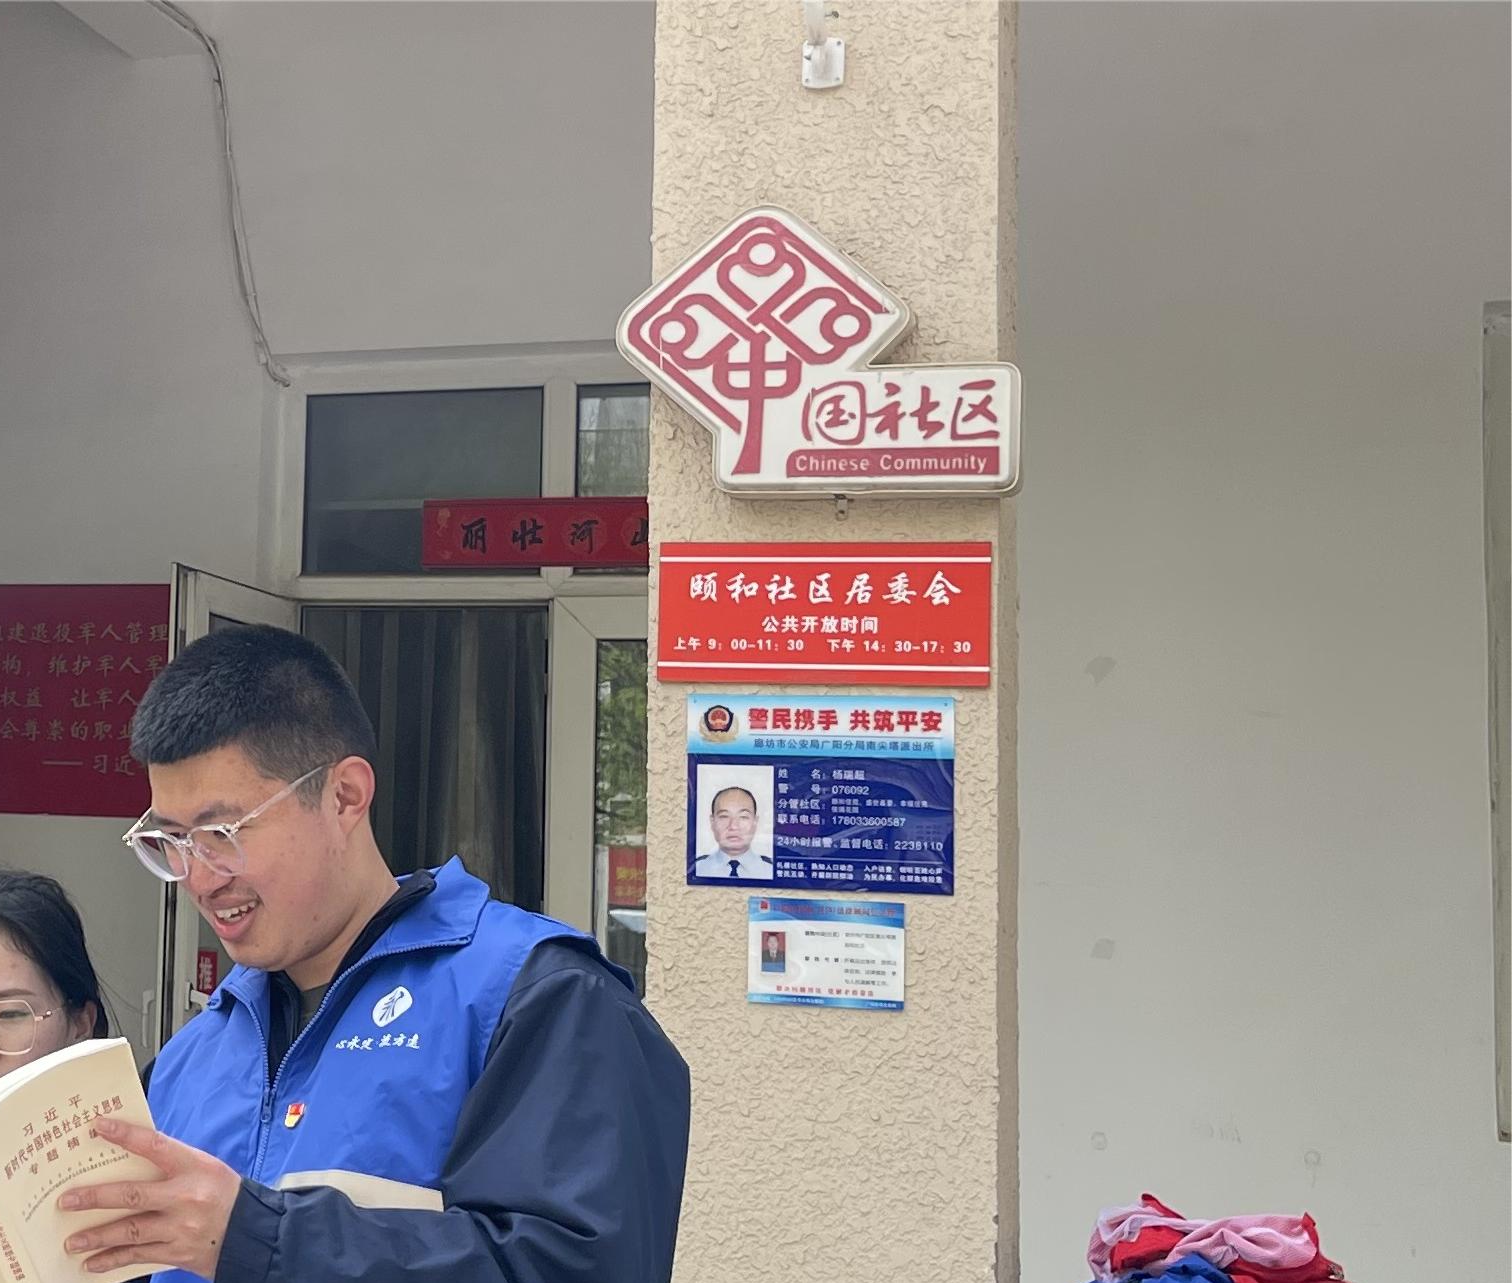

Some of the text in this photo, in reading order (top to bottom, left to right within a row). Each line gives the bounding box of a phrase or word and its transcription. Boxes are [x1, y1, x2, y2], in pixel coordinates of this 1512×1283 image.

[794, 455, 988, 475] Chinese Community
[689, 570, 962, 606] 颐和社区居委会
[761, 616, 880, 635] 公共开放时间
[673, 636, 702, 651] 上午
[827, 638, 856, 654] 下午
[748, 707, 943, 733] 警民携手 共筑平安
[21, 1094, 83, 1138] 习近平
[3, 1095, 125, 1182] 新时代中国特色社会主义思想
